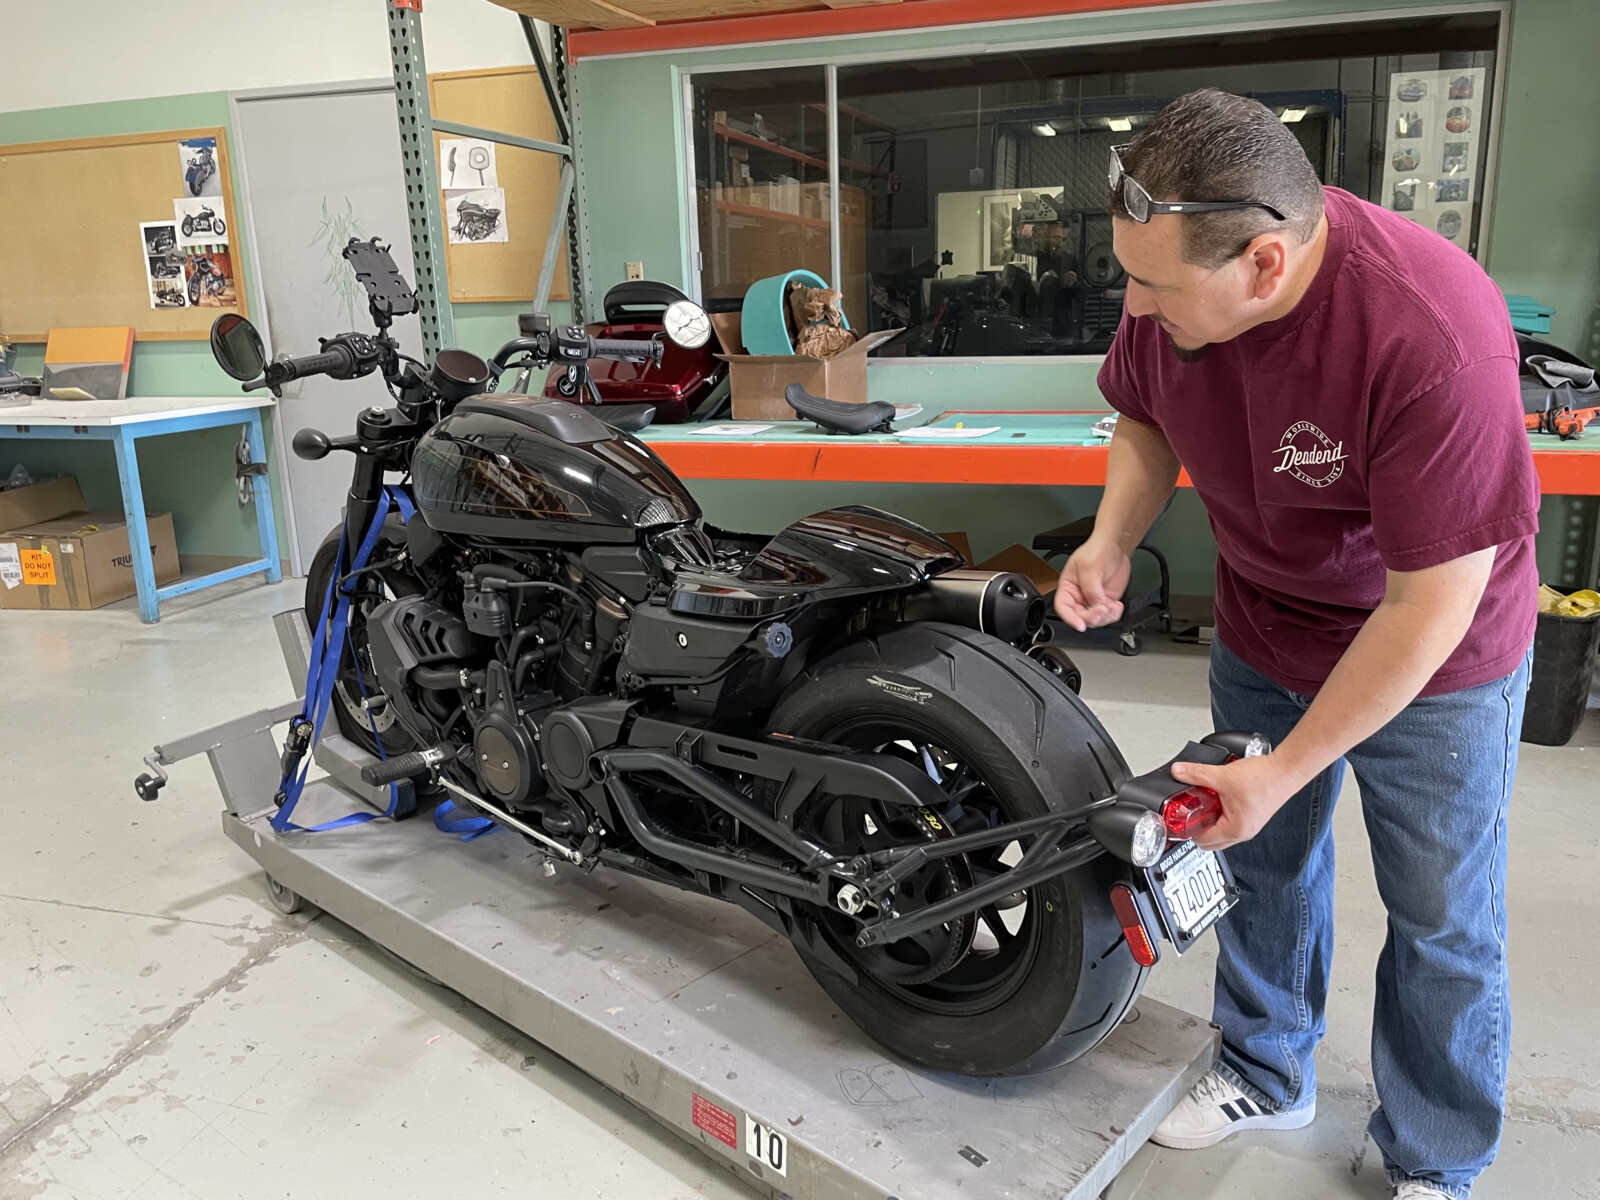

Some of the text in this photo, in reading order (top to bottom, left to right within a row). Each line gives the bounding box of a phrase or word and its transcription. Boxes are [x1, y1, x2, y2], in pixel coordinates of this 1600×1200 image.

[1285, 423, 1329, 446] WORLDWIDE
[1272, 440, 1349, 473] Deadend
[1296, 472, 1322, 487] SINCE
[29, 571, 49, 579] SPLIT
[1191, 922, 1203, 937] SAN
[1219, 899, 1229, 910] CA
[753, 1122, 784, 1171] 10
